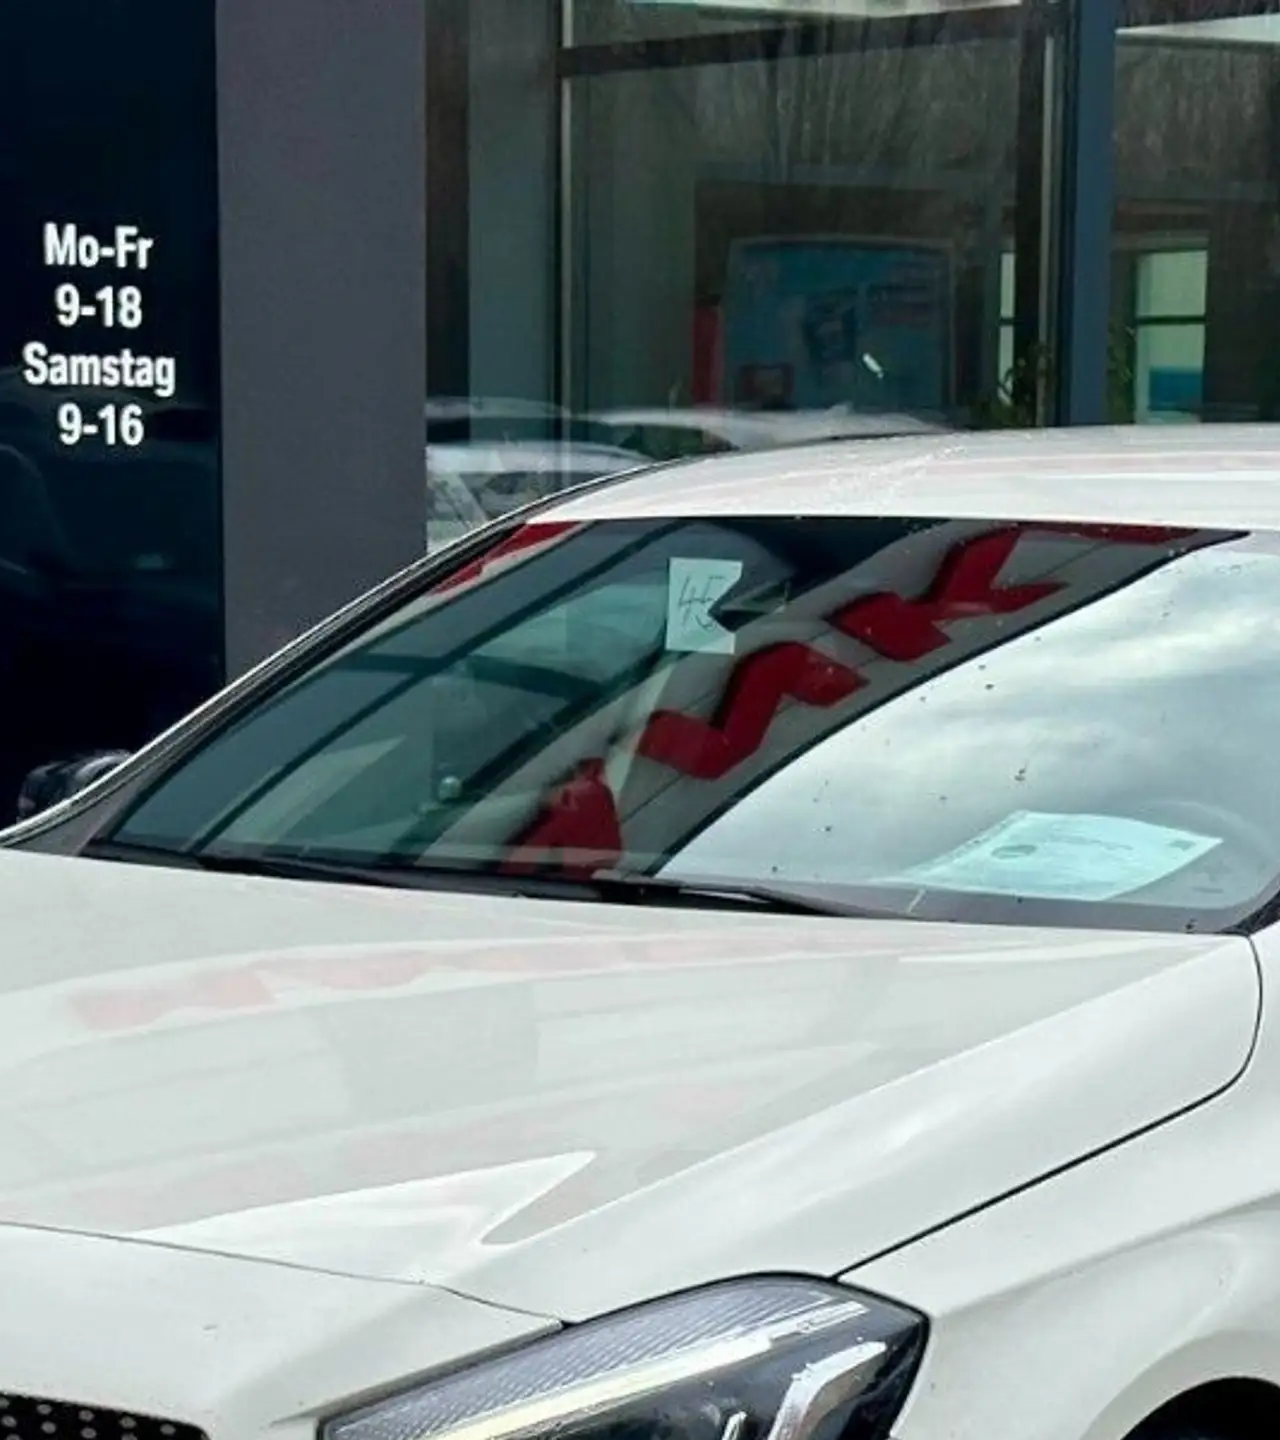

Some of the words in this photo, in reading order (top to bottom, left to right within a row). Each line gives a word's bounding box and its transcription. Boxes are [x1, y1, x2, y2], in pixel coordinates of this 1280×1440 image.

[43, 220, 154, 270] Mo-Fr
[55, 282, 143, 328] 9-18
[22, 340, 176, 396] Samstag
[57, 402, 144, 446] 9-16
